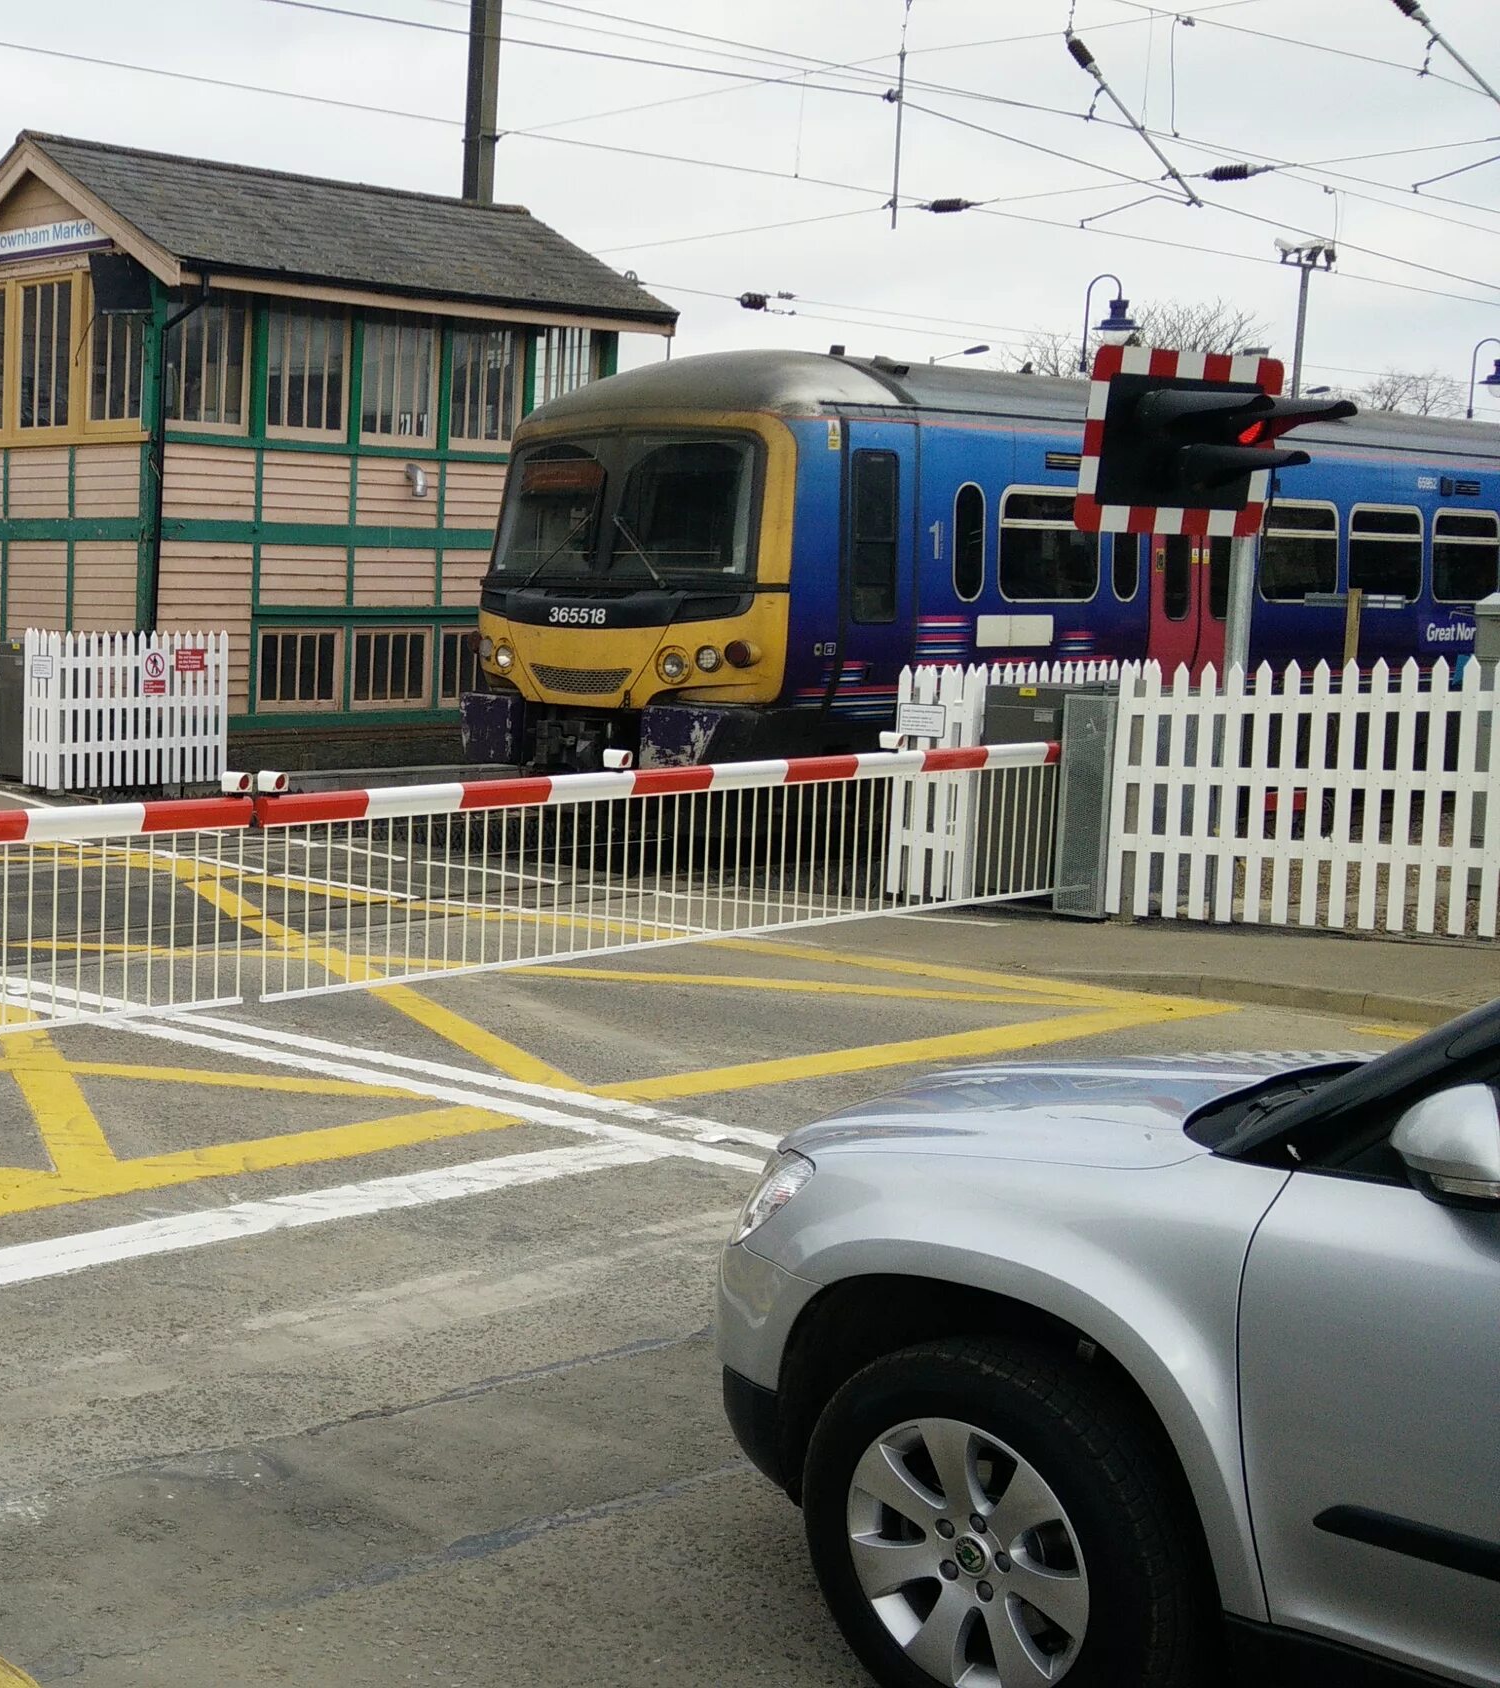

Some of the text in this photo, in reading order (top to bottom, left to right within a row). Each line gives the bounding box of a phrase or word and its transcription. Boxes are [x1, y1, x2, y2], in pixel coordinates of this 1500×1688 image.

[52, 220, 97, 241] Market
[548, 606, 606, 624] 365518
[1426, 622, 1456, 642] Great
